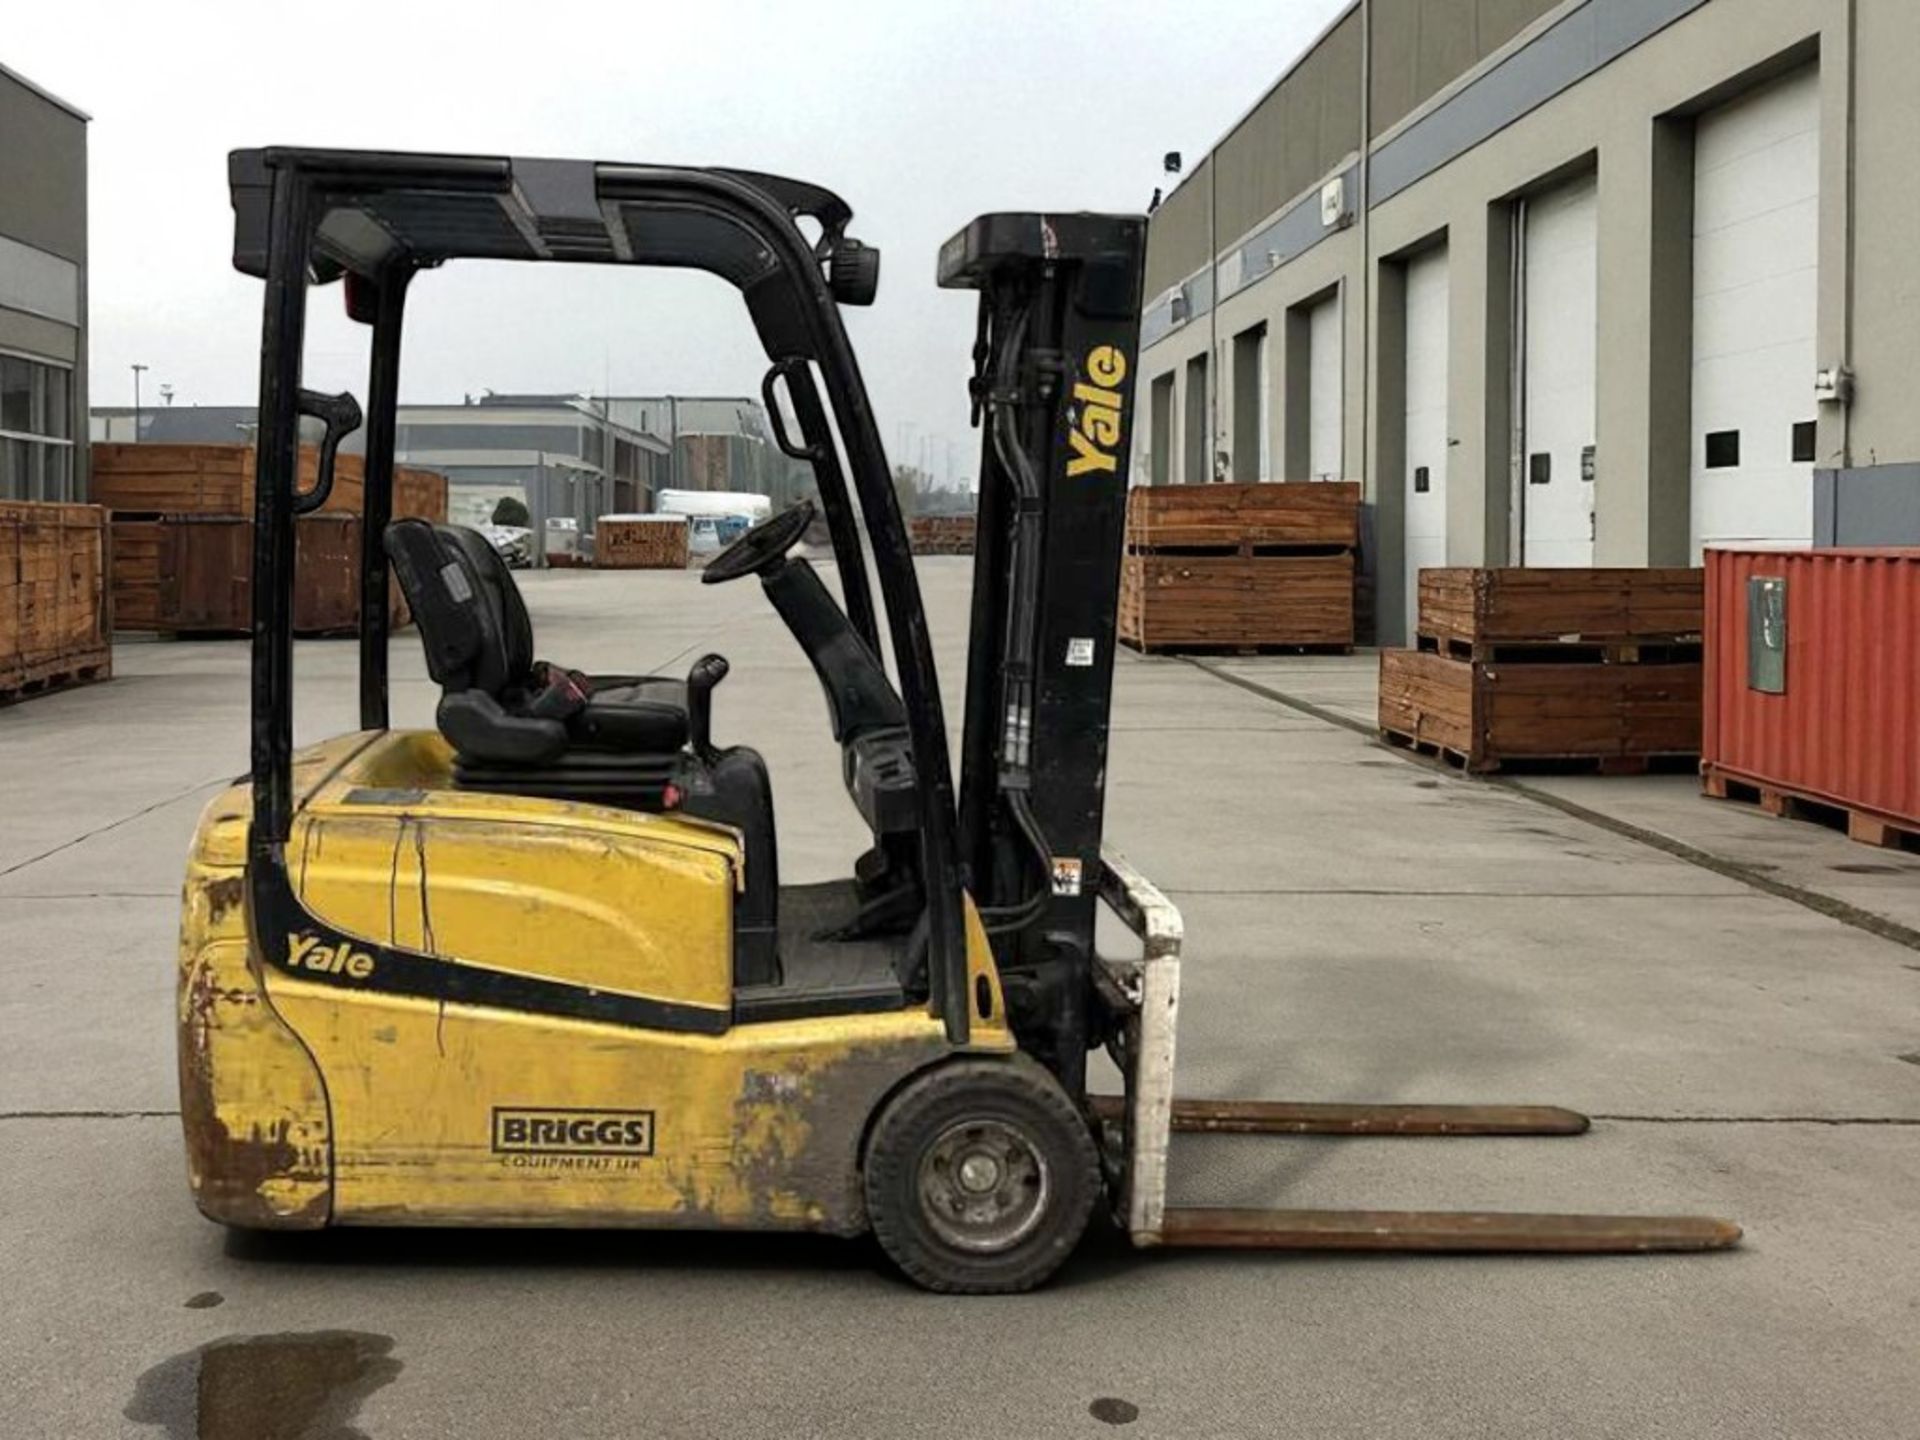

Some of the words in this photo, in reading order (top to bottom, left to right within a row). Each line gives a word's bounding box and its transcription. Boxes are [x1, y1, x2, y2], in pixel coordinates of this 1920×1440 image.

[1066, 345, 1126, 477] Yale
[287, 933, 375, 978] Yale
[503, 1119, 643, 1146] BRIGGS
